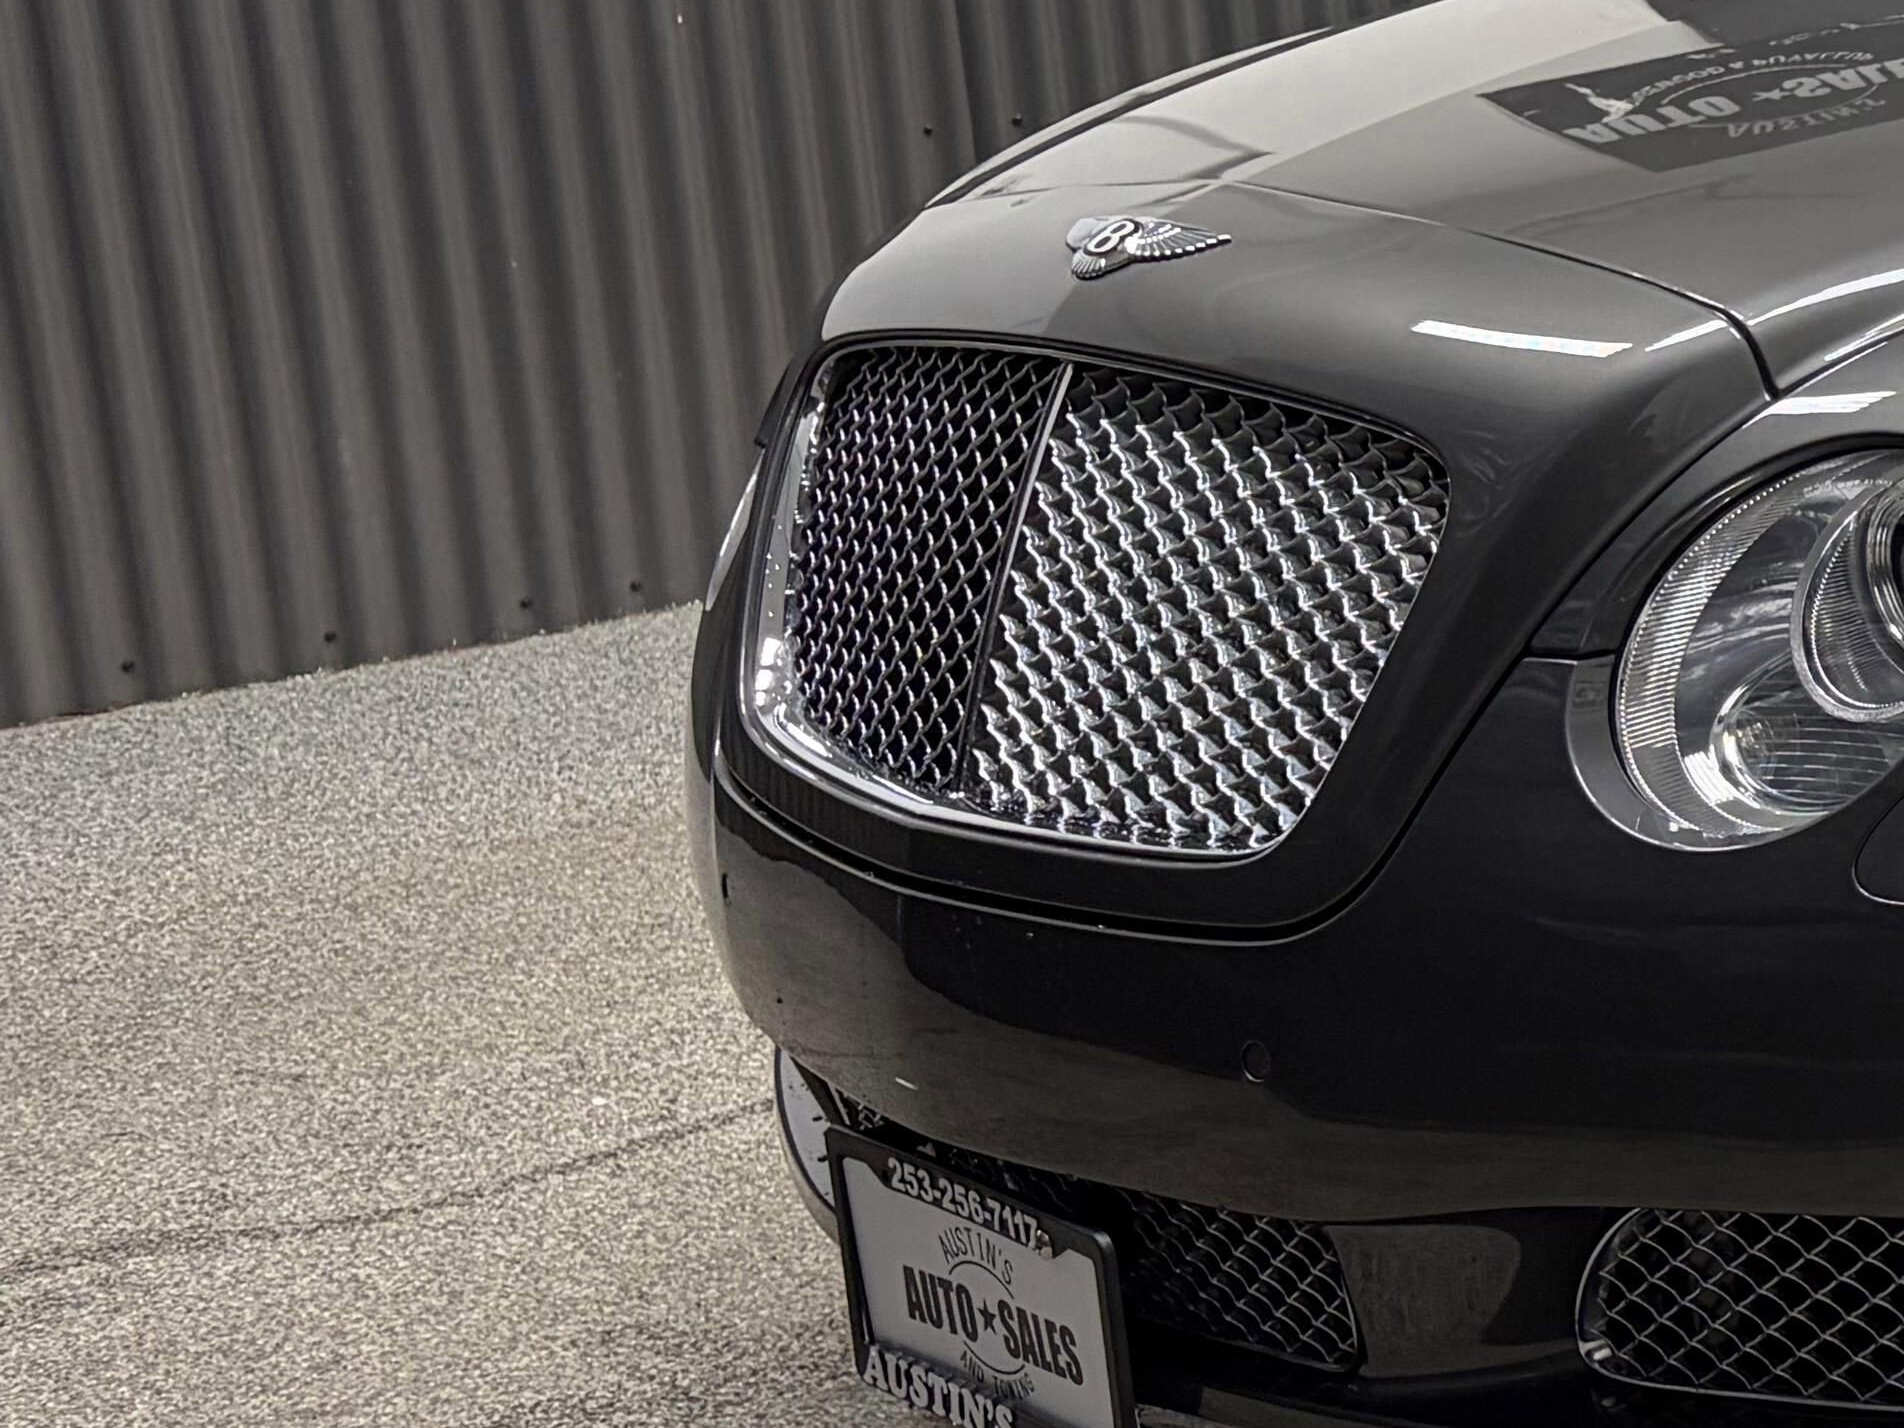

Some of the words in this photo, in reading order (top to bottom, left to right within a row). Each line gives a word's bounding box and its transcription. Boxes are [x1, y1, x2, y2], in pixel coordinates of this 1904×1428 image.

[888, 1156, 1039, 1250] 253-256-7117
[937, 1225, 1014, 1285] AUSTIN'S
[903, 1264, 979, 1343] AUTO
[997, 1298, 1084, 1387] SALES
